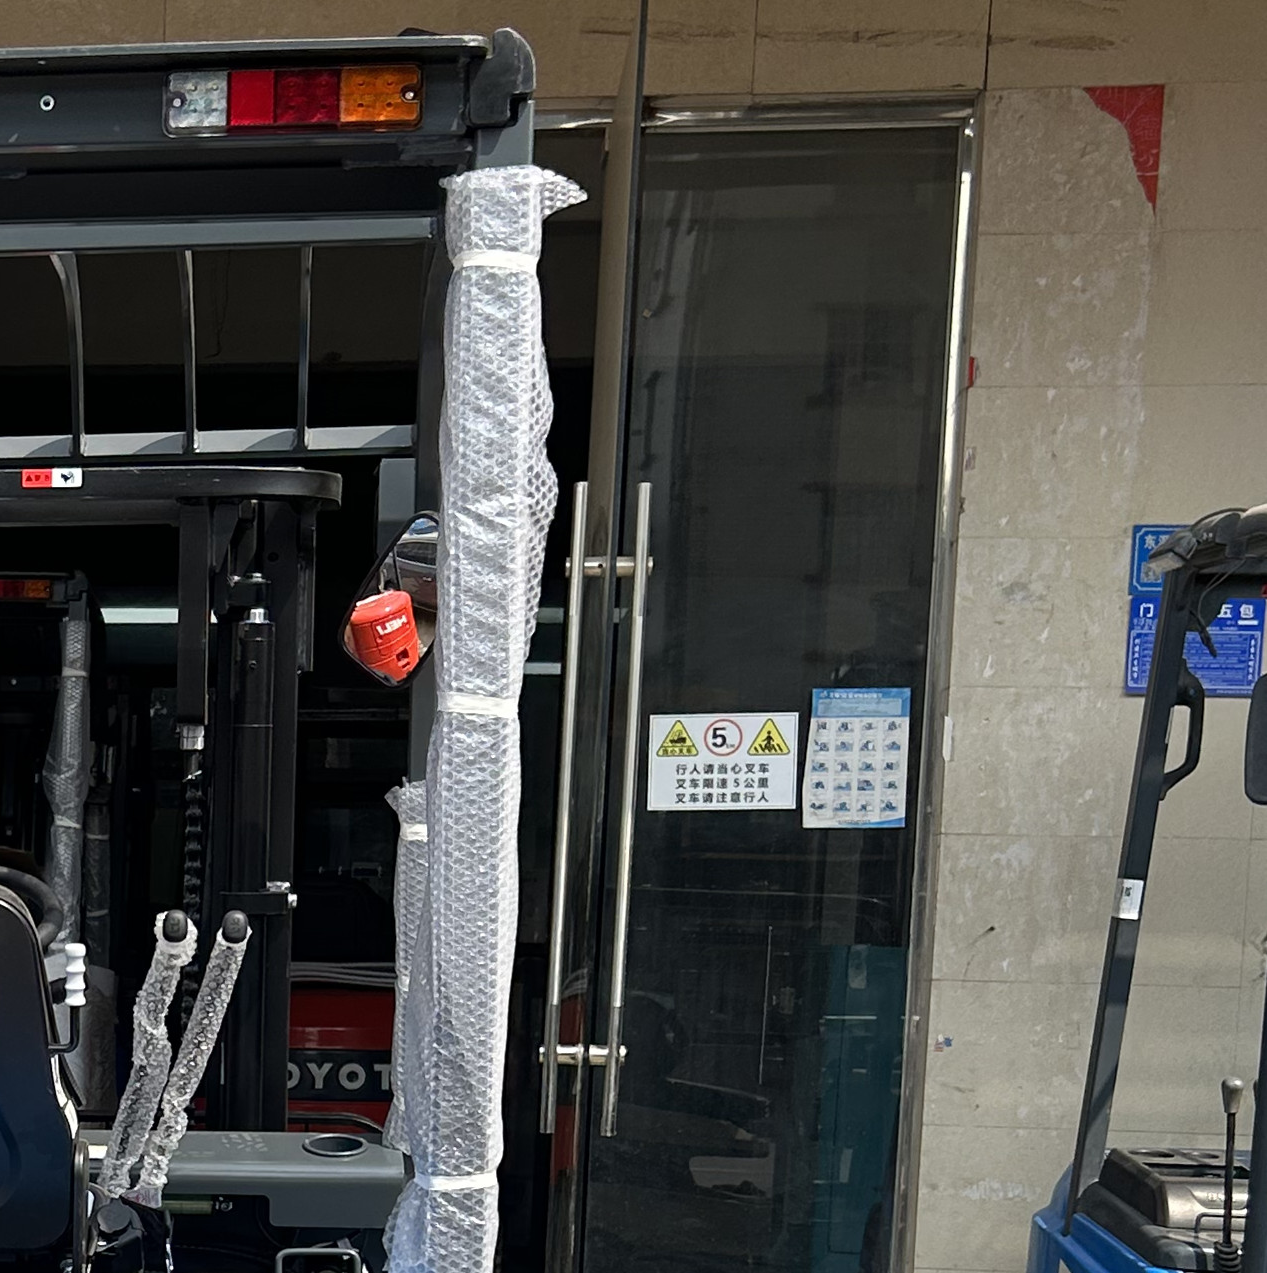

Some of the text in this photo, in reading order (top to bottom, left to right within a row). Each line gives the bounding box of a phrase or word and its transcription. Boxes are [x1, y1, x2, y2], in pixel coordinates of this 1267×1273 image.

[711, 726, 727, 749] 5
[675, 763, 770, 775] 行人请当心叉车
[675, 791, 770, 804] 叉车请注意行人
